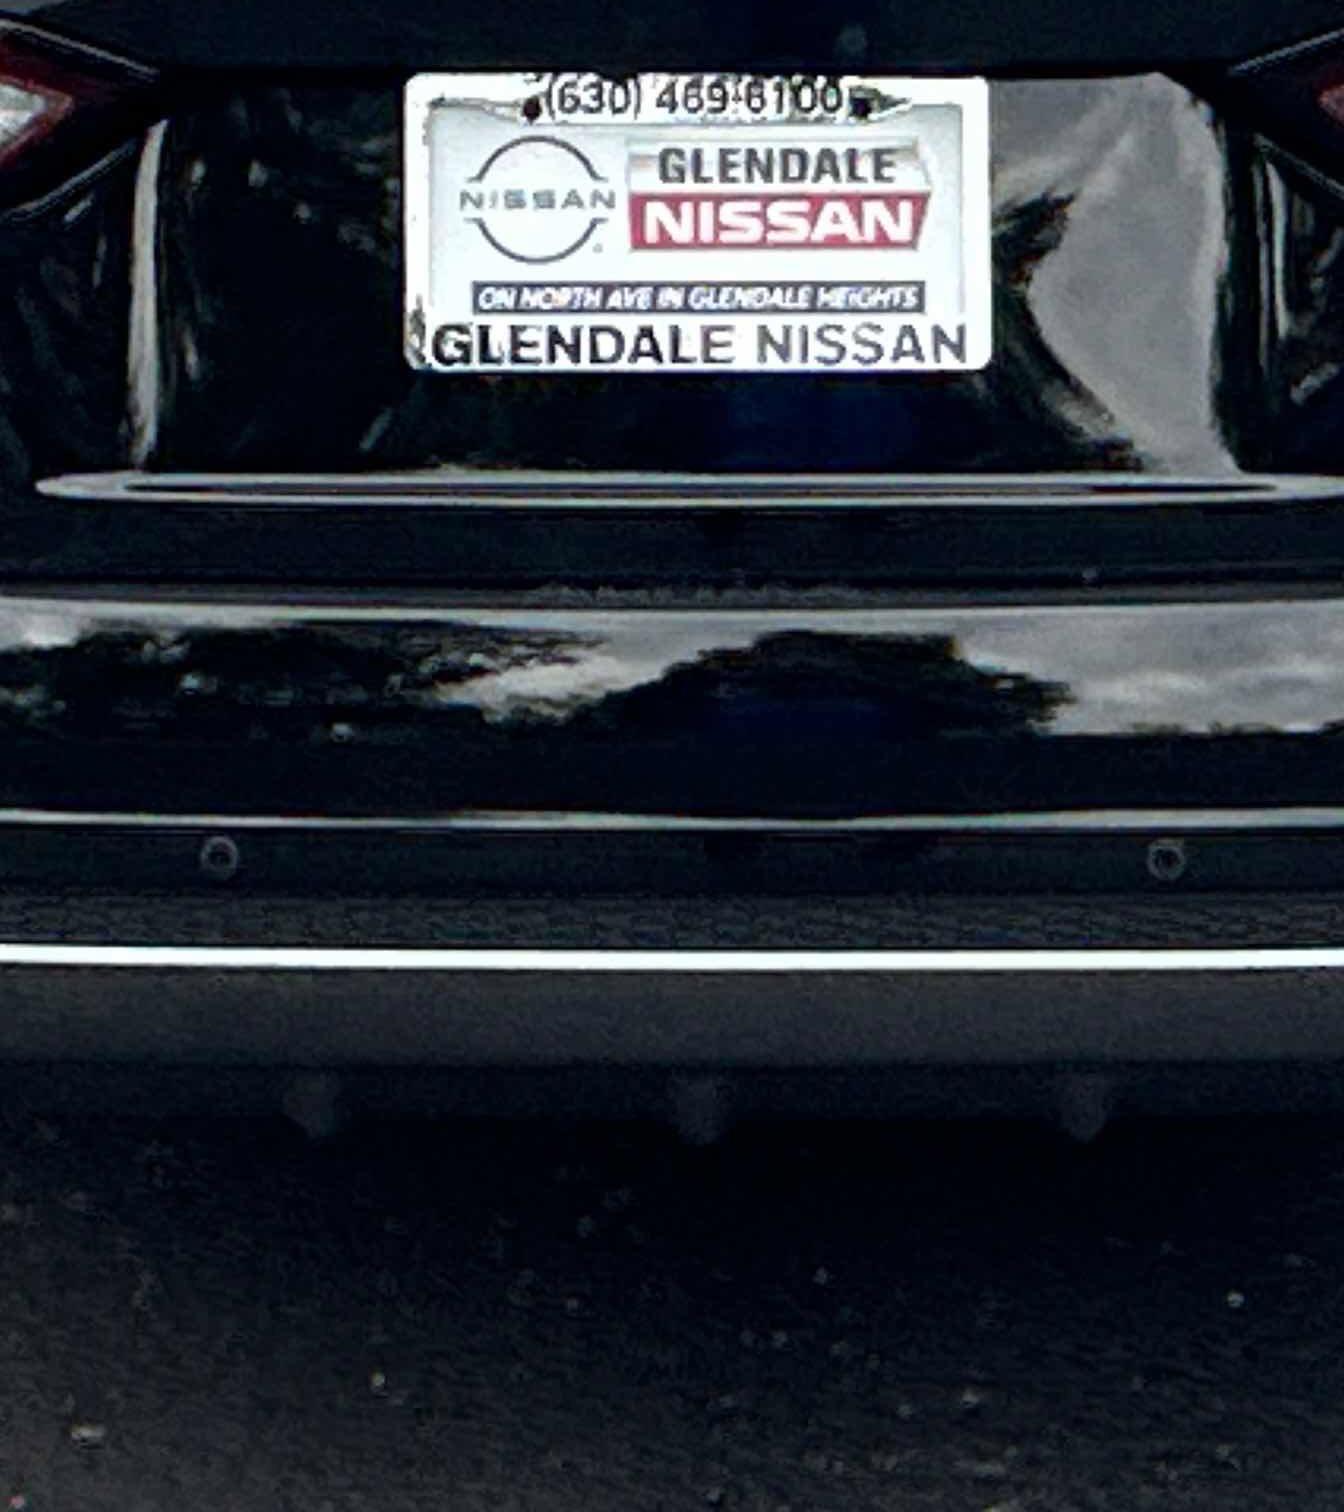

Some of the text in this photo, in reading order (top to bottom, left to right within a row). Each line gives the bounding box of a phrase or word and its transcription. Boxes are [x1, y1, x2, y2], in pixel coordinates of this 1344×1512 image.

[544, 79, 641, 121] (630)
[657, 146, 898, 185] GLENDALE
[459, 188, 616, 210] NISSAN
[644, 199, 916, 245] NISSAN
[478, 286, 919, 310] ON NORTH AVE IN GLENDALE HEIGHTS
[431, 323, 968, 366] GLENDALE NISSAN
